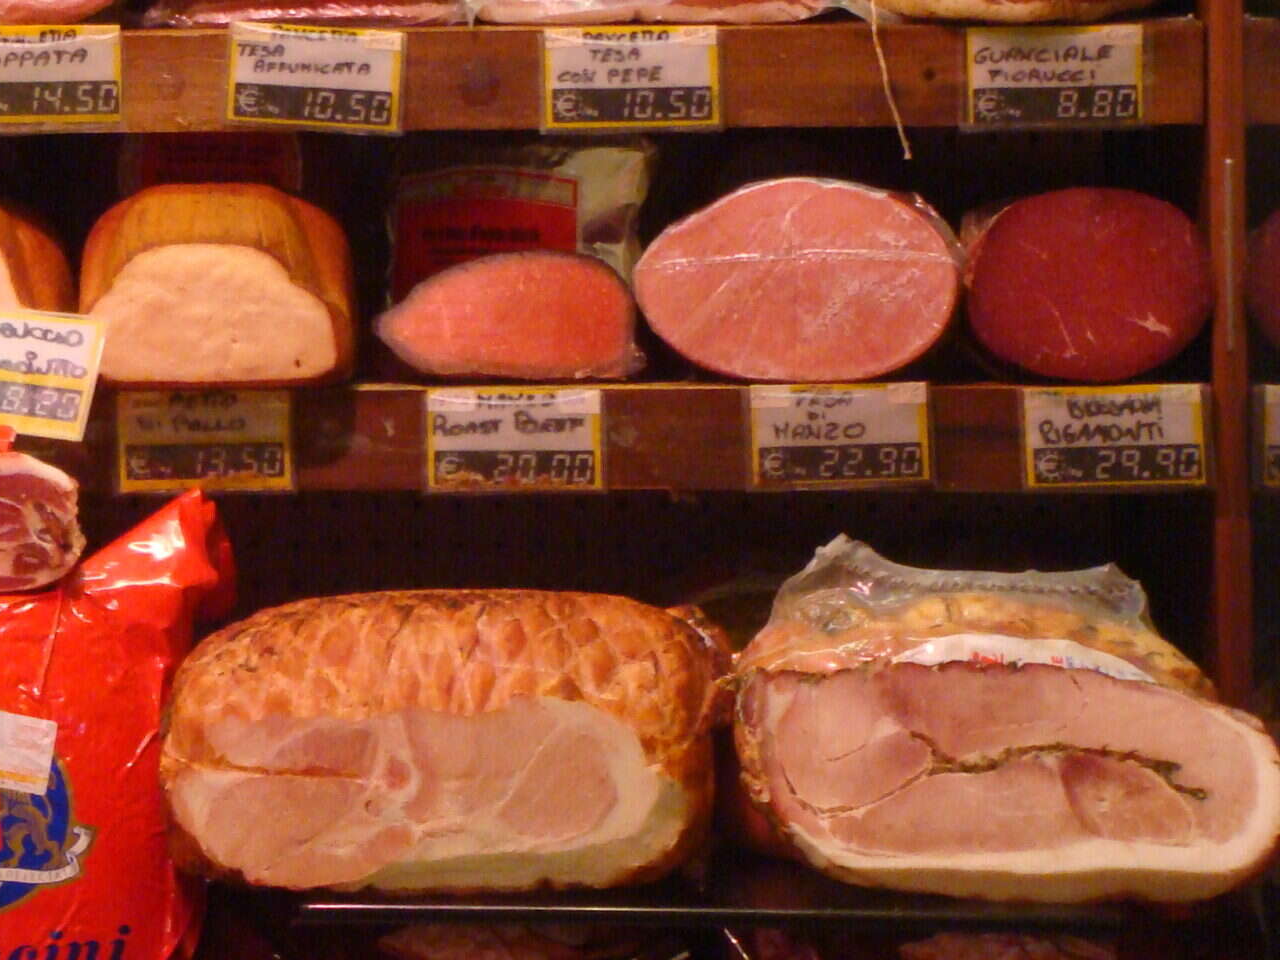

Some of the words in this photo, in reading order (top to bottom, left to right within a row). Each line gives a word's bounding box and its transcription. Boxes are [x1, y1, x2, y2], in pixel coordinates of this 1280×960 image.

[238, 44, 285, 57] TESA
[589, 47, 641, 63] TESA
[975, 44, 1113, 64] GUANCIALE
[608, 66, 663, 83] PEPE
[33, 85, 117, 113] 14.50
[304, 90, 391, 122] 10.50
[624, 91, 710, 118] 10.50
[1057, 89, 1137, 118] 8.80
[0, 385, 80, 420] 8.20
[821, 447, 920, 476] 22.90
[1096, 449, 1199, 478] 29.90
